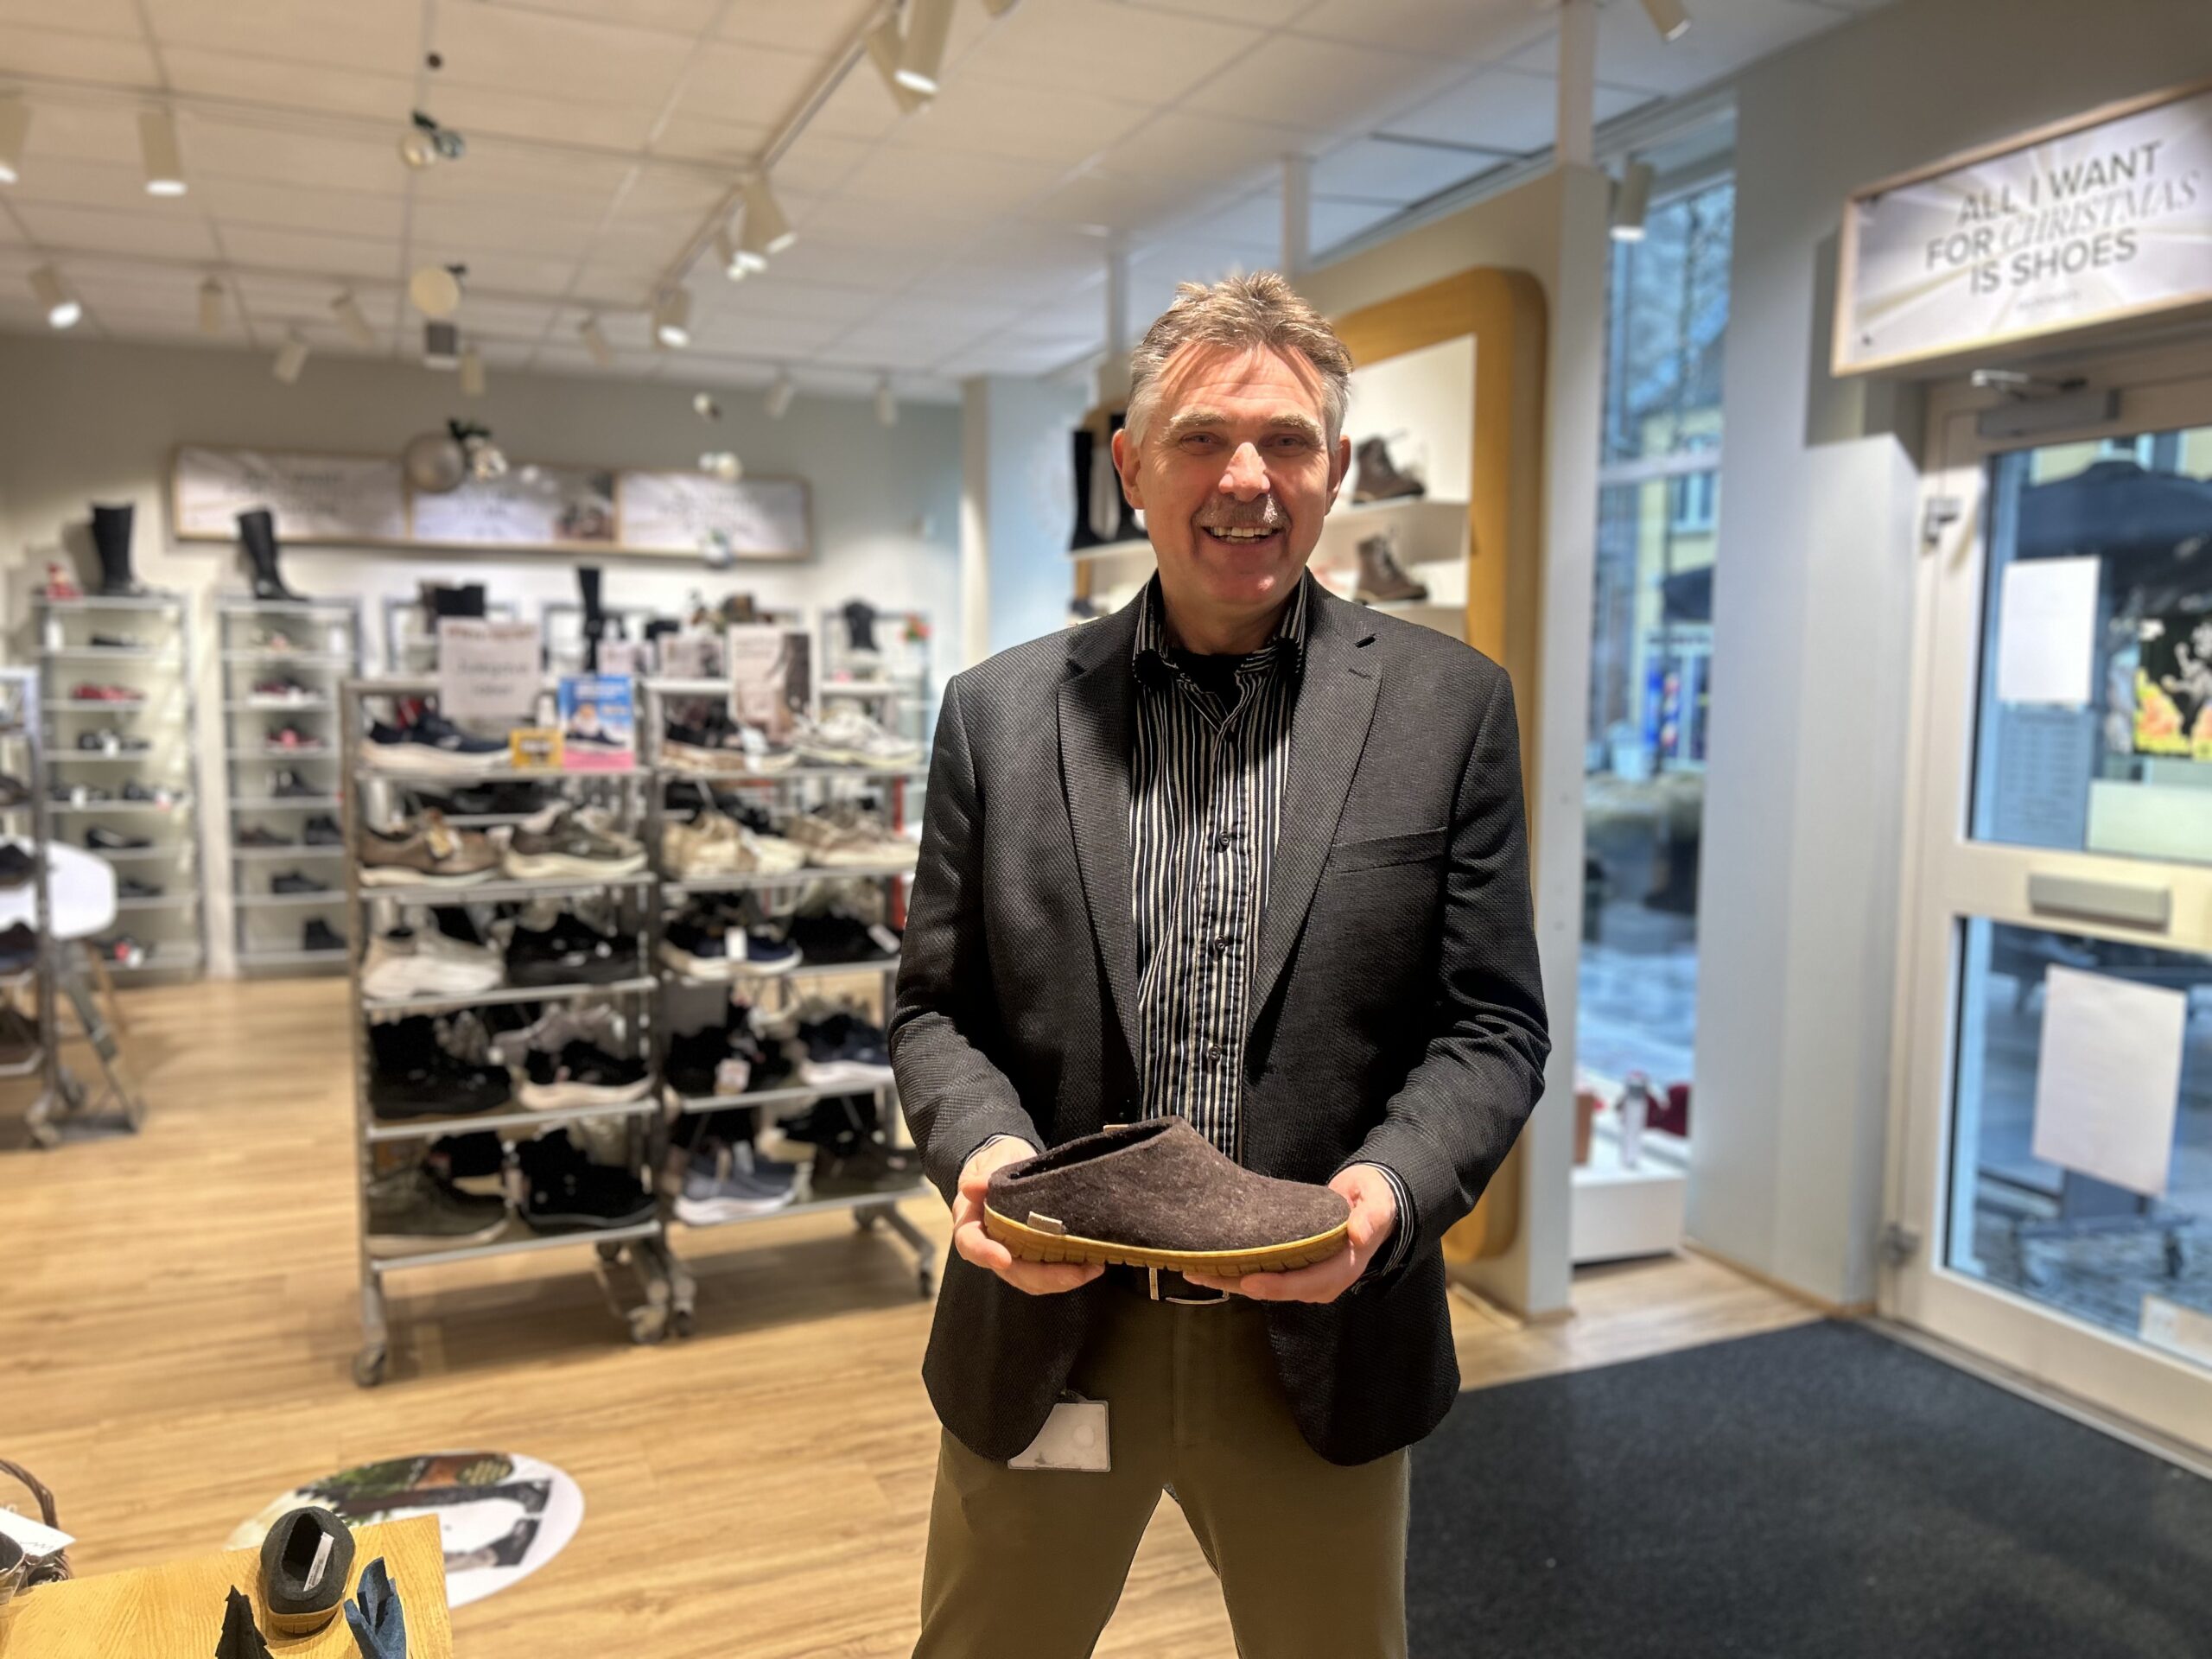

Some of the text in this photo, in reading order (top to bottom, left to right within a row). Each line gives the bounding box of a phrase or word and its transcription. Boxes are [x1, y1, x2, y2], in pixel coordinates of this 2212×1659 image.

[1926, 169, 2200, 270] FOR CHRISTMAS
[1958, 140, 2162, 225] ALL I WANT
[1970, 227, 2138, 295] IS SHOES
